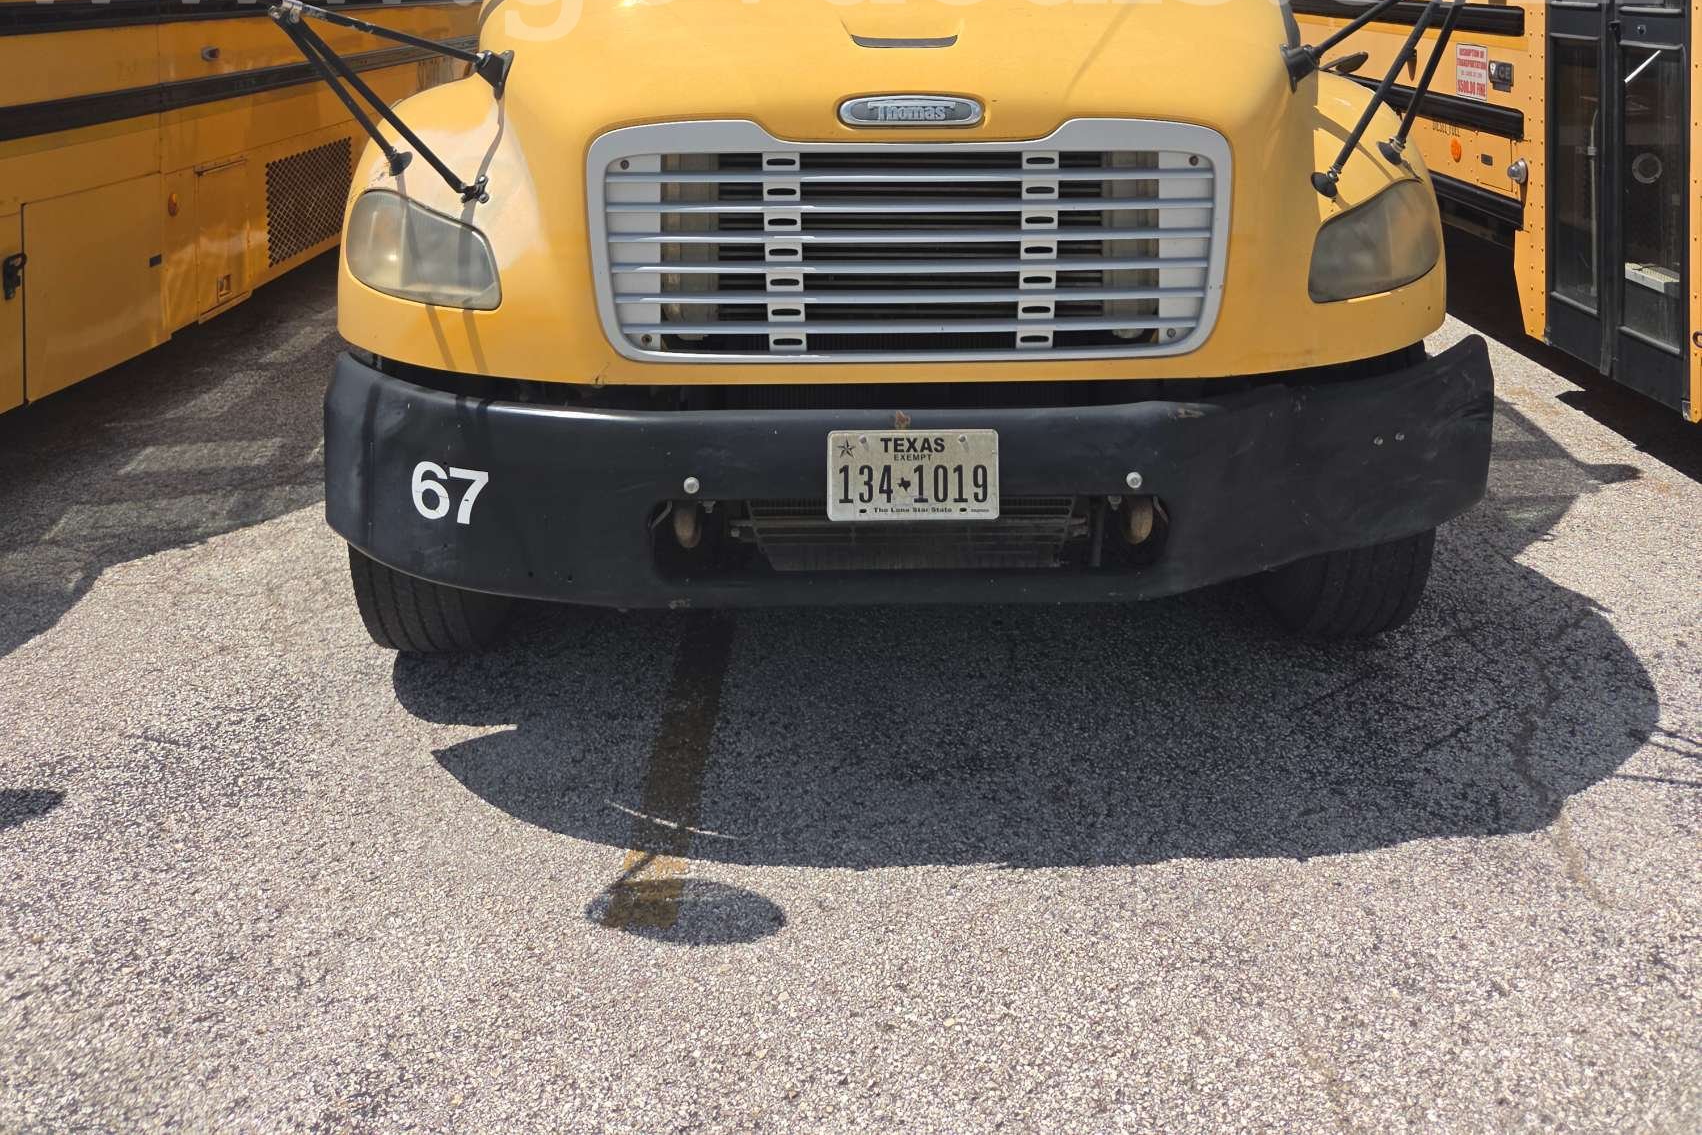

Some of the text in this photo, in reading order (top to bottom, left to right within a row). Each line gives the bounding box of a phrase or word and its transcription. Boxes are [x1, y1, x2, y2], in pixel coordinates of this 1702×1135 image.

[868, 101, 955, 121] Thomas
[880, 437, 945, 453] TEXAS
[893, 454, 933, 462] EXEMPT
[411, 461, 489, 525] 67
[838, 464, 988, 504] 134 1019
